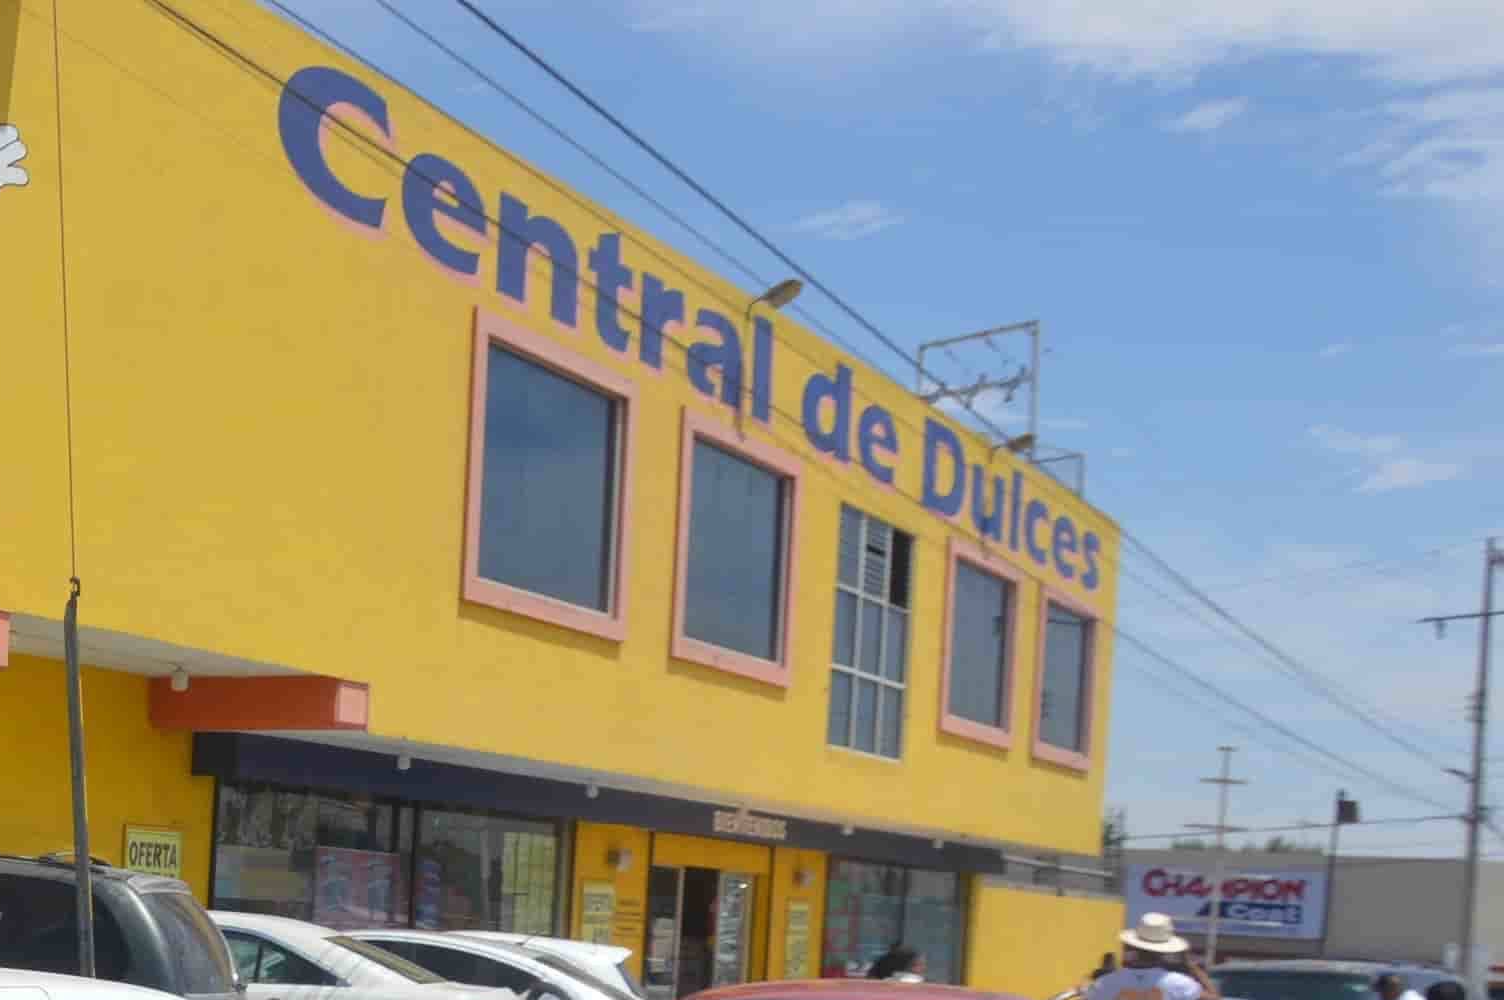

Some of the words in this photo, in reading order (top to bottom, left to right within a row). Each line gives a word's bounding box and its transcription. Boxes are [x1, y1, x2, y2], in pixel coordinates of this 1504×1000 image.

[278, 66, 773, 423] Central
[802, 361, 898, 484] de
[923, 416, 1100, 590] Dulces
[128, 840, 177, 868] OFERTA
